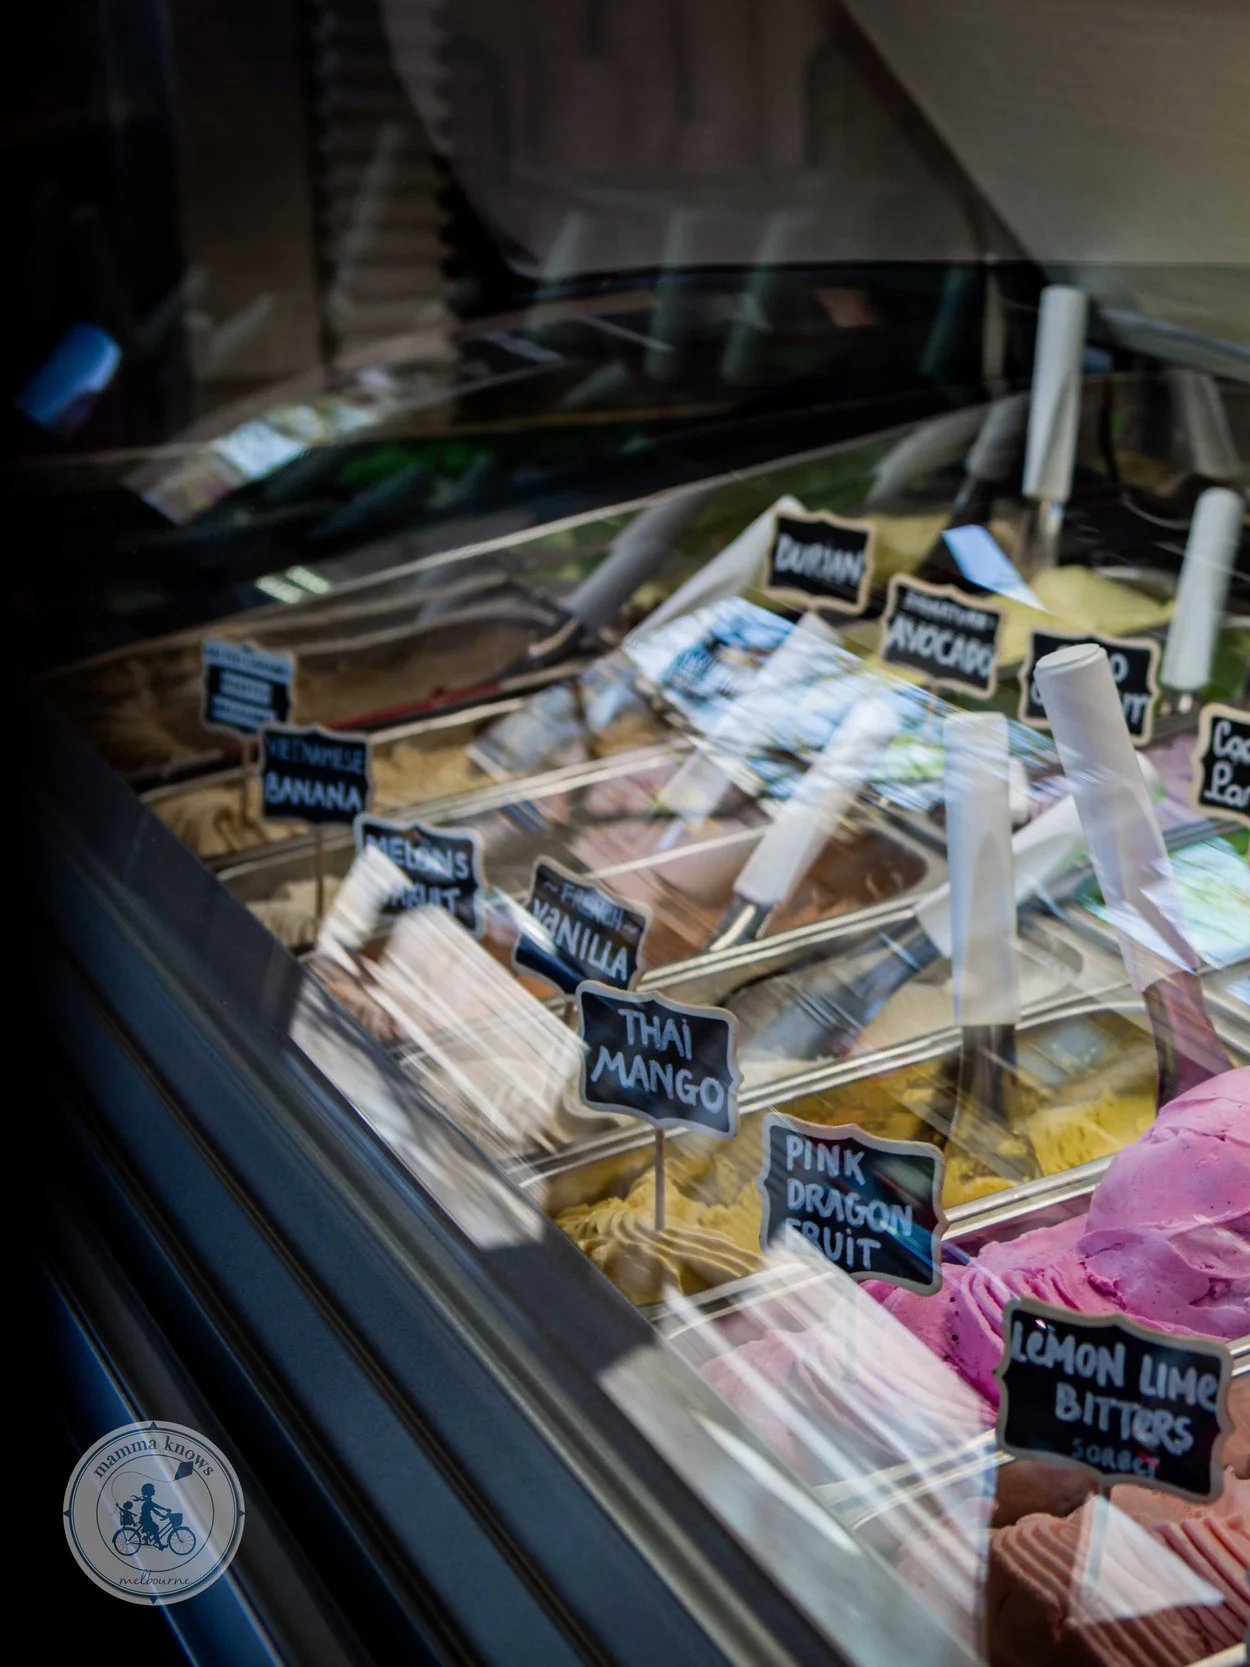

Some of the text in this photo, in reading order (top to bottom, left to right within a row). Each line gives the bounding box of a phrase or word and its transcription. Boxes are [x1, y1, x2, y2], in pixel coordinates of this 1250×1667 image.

[885, 614, 993, 678] AVOCADO
[266, 773, 363, 812] BANANA
[591, 1047, 724, 1114] MANGO
[786, 1135, 866, 1185] PINK
[786, 1178, 913, 1236] DRAGON
